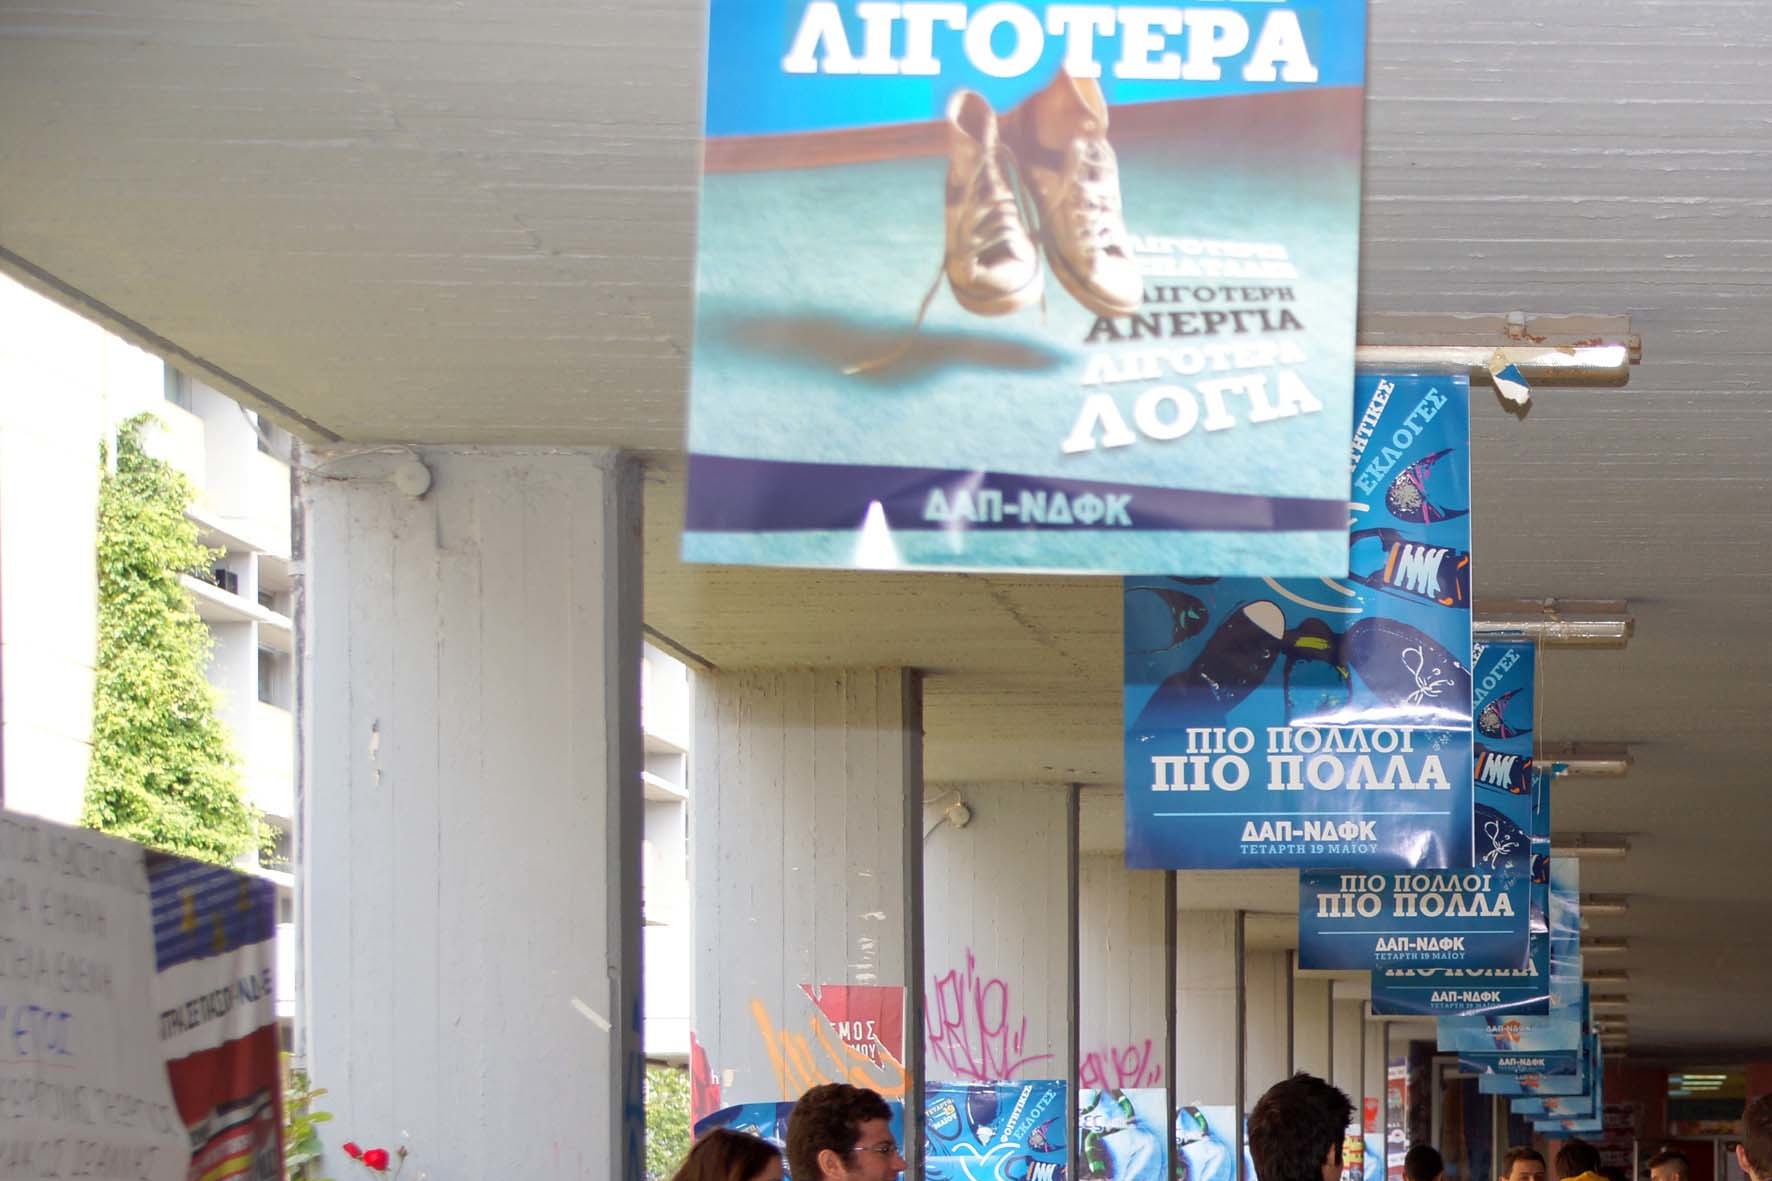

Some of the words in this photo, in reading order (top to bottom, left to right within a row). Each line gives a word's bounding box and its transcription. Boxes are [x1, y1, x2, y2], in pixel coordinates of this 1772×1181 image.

[781, 1, 1319, 82] ΛΙΓΟΤΕΡΑ
[1082, 307, 1306, 345] ΑΝΕΡΓΙΑ
[1060, 367, 1324, 453] ΛΟΓΙΑ
[1354, 387, 1448, 496] ΕΚΛΟΓΕΣ
[923, 488, 1133, 526] ΔΑΠ-ΝΔΦΚ
[1473, 648, 1521, 710] ΛΟΓΕΣ
[1186, 727, 1255, 754] ΠΙΟ
[1266, 727, 1414, 753] ΠΟΛΛΟΙ
[1151, 755, 1250, 791] ΠΙΟ
[1267, 755, 1451, 791] ΠΟΛΛΑ
[1240, 821, 1377, 842] ΔΑΠ-ΝΔΦΚ
[1240, 844, 1306, 855] ΤΕΤΑΡΤΗ
[1310, 844, 1325, 855] 19
[1340, 874, 1386, 893] ΠΙΟ
[1393, 874, 1492, 893] ΠΟΛΛΟΙ
[1316, 893, 1382, 918] ΠΙΟ
[1393, 892, 1515, 917] ΠΟΛΛΑ
[1375, 936, 1465, 952] ΔΑΠ-ΝΔΦΚ
[1430, 991, 1501, 1002] ΔΑΠ-ΝΔΦΚ
